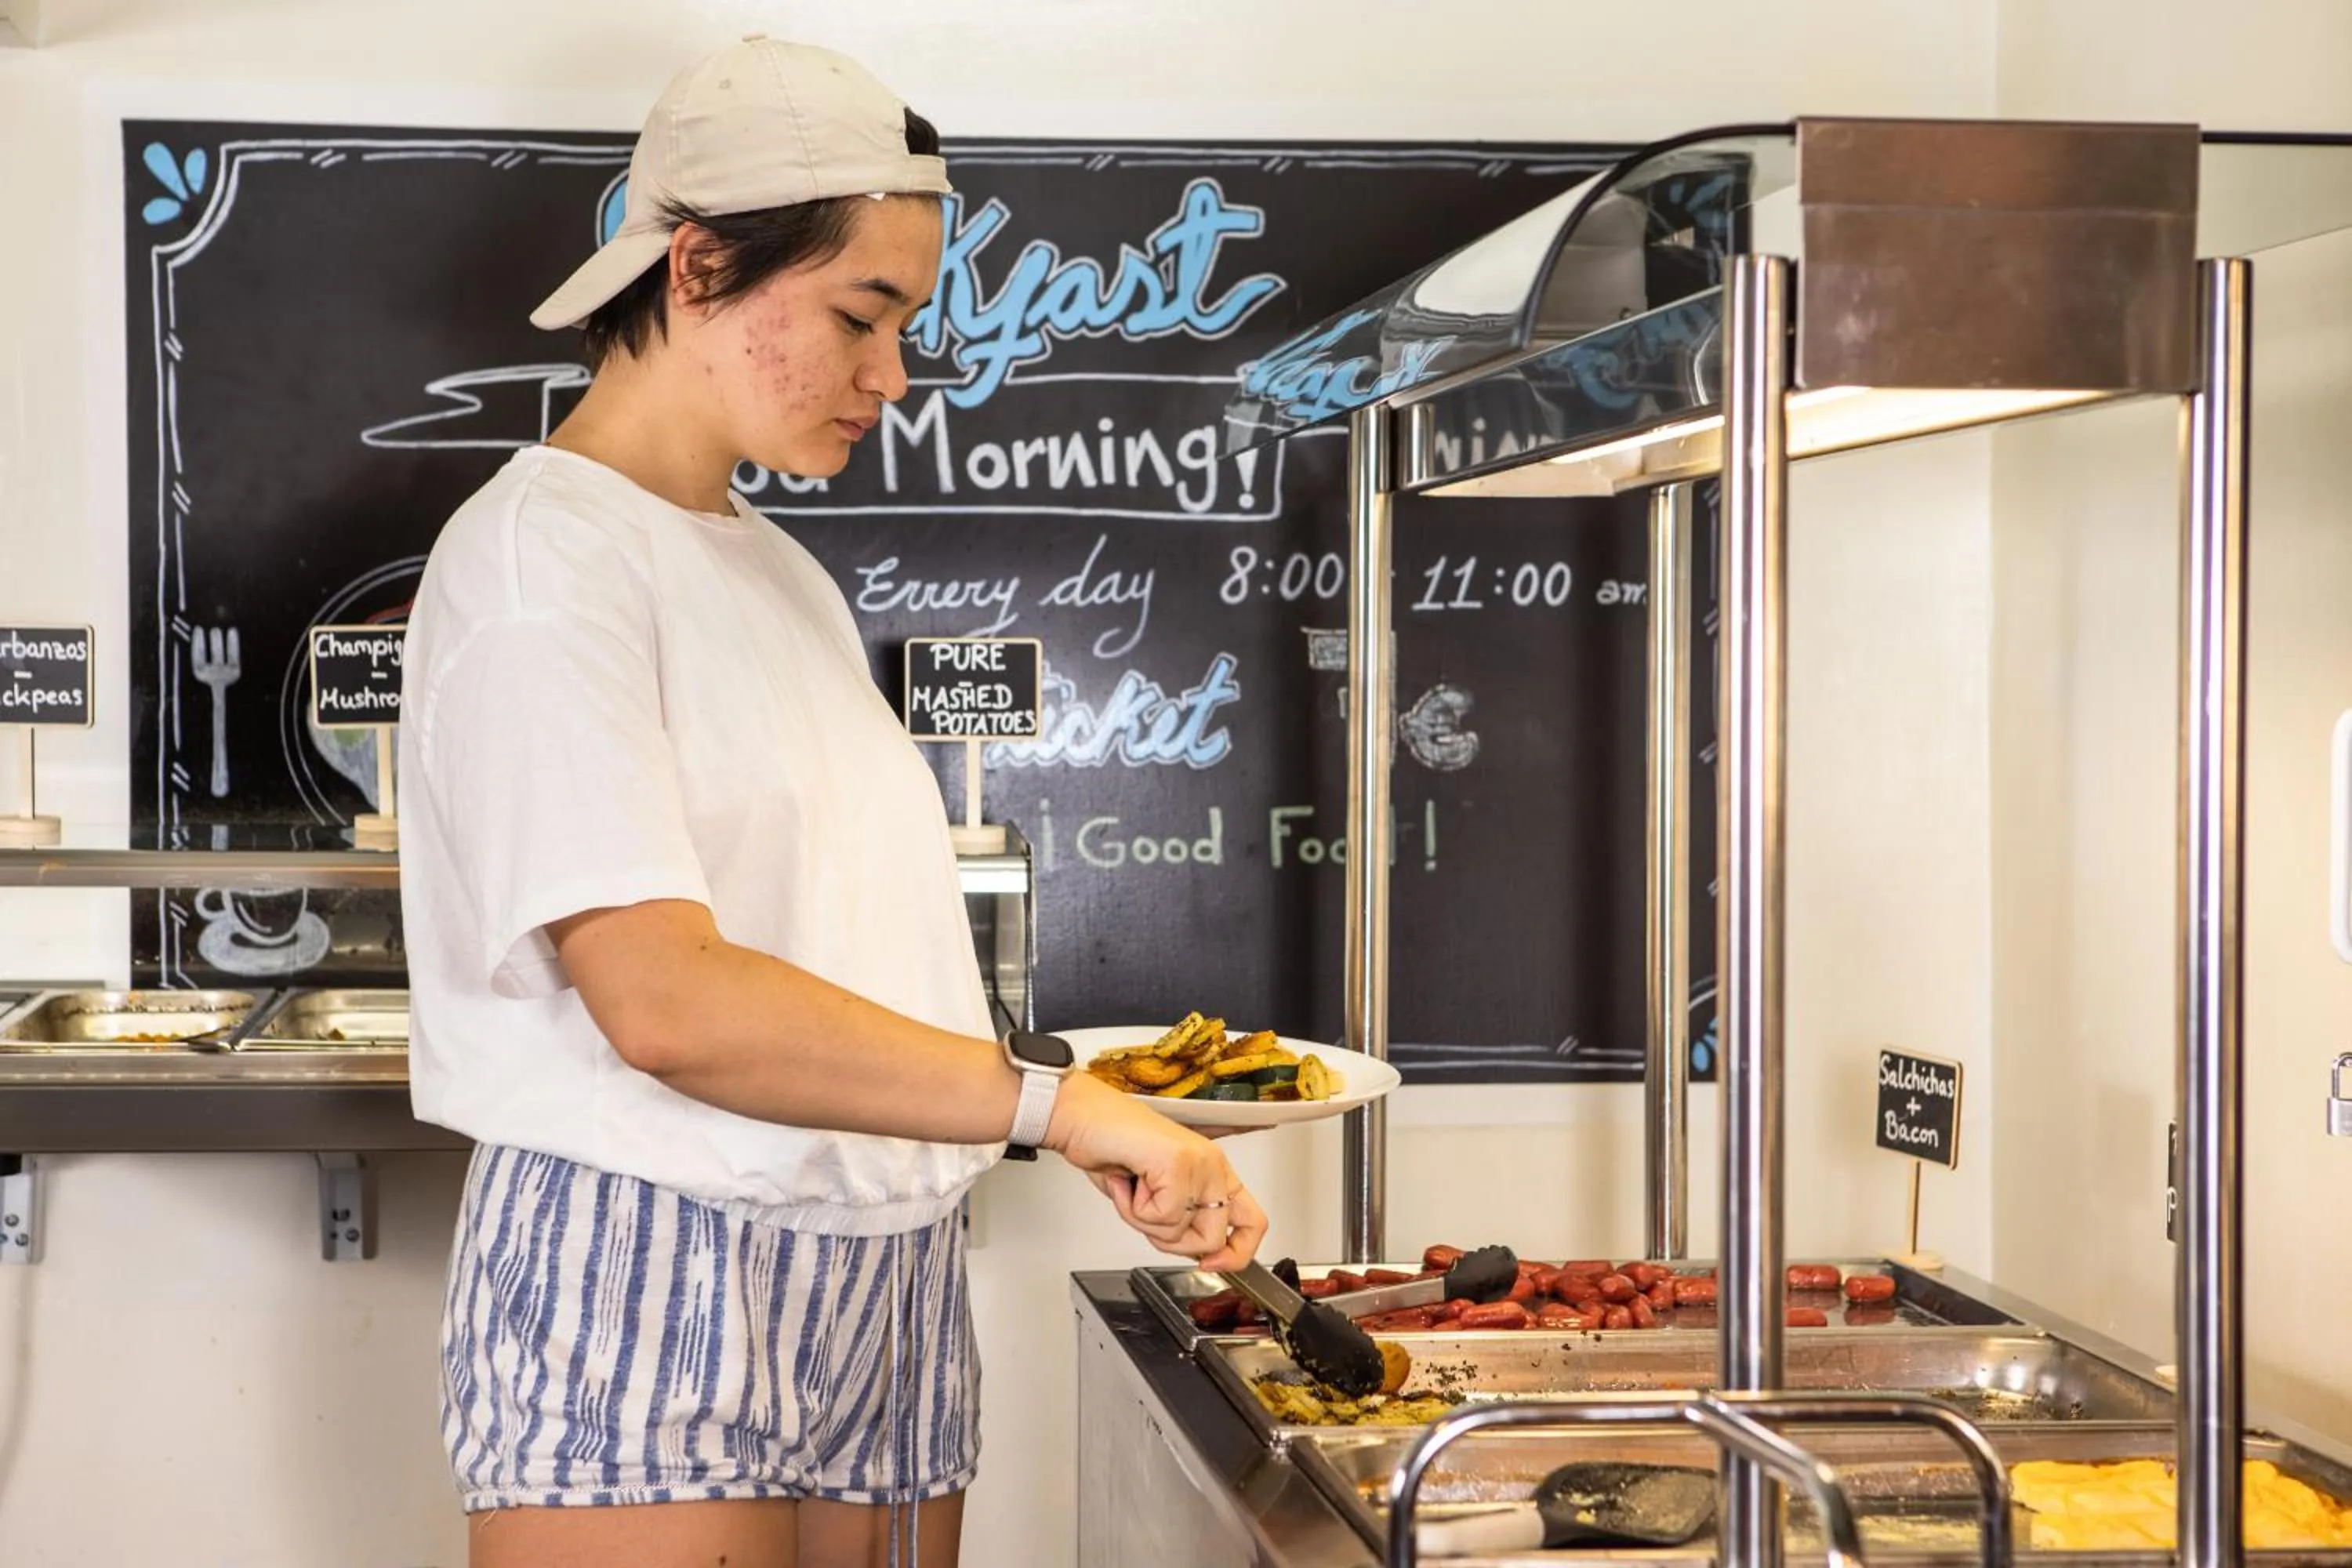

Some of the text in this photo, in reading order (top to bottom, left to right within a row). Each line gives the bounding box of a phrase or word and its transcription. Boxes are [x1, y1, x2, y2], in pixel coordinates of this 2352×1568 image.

[880, 389, 1255, 514] Morning!
[1039, 534, 1154, 659] day
[1220, 546, 1343, 605] 8:00
[1412, 555, 1571, 611] 11:00
[0, 630, 86, 662] rbanzos
[315, 633, 402, 667] Champig
[929, 643, 1007, 672] PURE
[2, 683, 82, 714] ckpeas
[319, 685, 401, 710] Mushro
[911, 684, 1013, 713] MASHED
[982, 652, 1241, 771] icket
[930, 709, 1036, 735] POTATOES
[1879, 1054, 1955, 1099] Salchichas
[1885, 1109, 1939, 1149] Bacon
